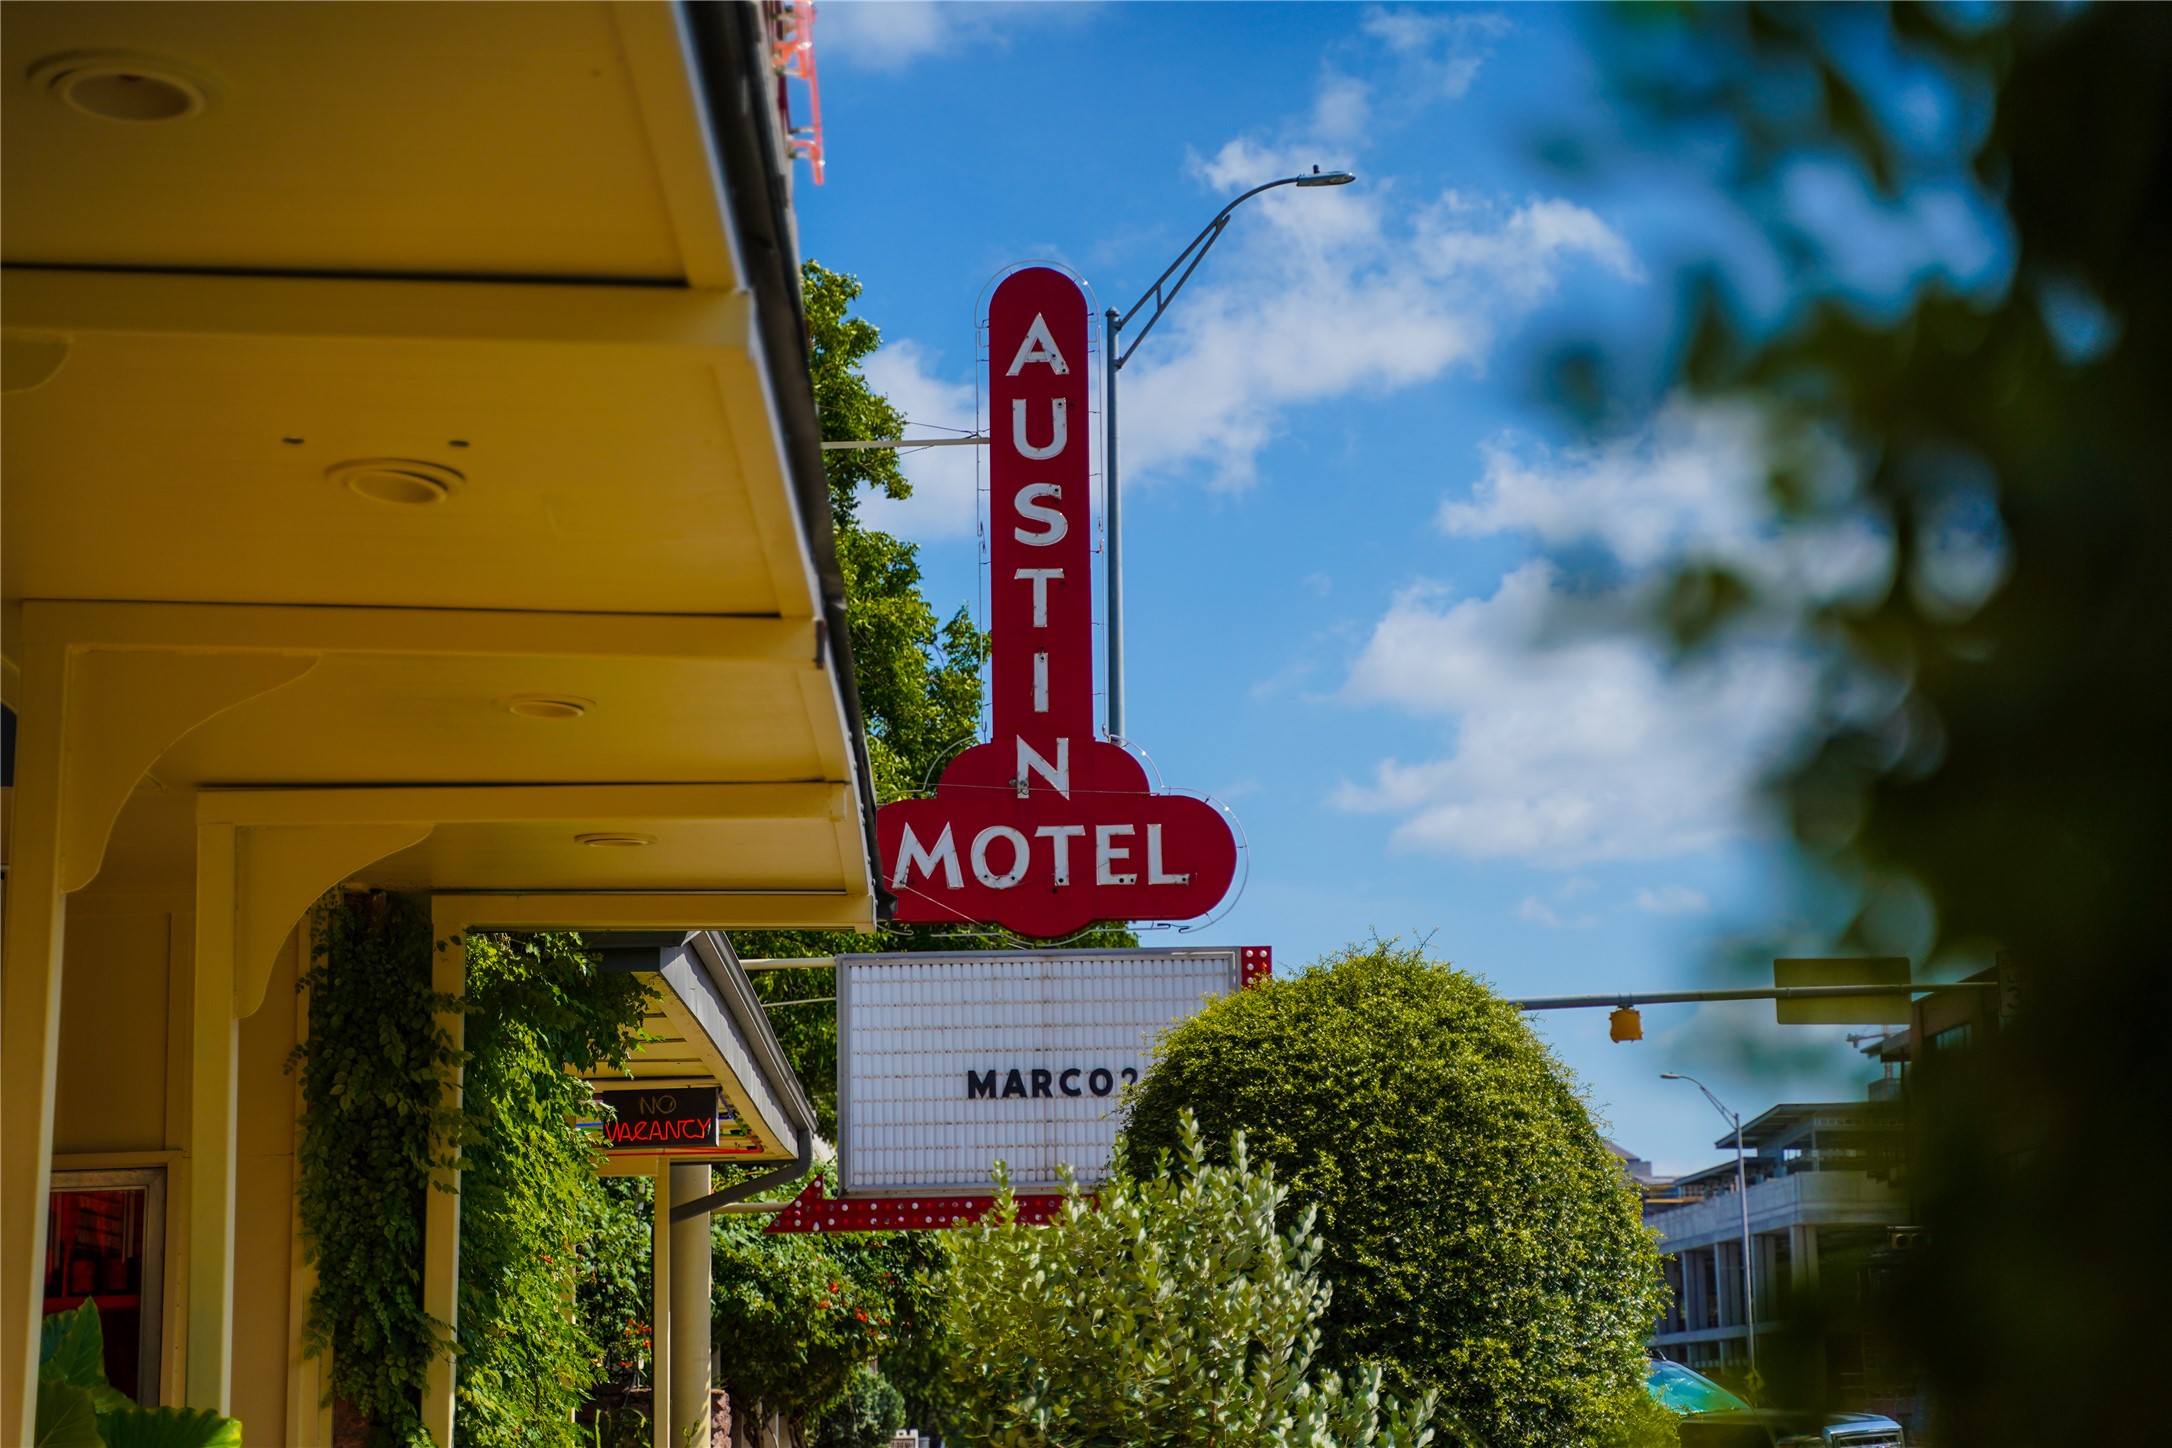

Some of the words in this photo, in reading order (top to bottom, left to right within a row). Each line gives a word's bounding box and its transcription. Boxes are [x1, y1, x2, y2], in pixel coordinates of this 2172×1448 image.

[1005, 312, 1070, 800] AUSTIN
[891, 821, 1190, 889] MOTEL
[967, 1067, 1138, 1098] MARCO?
[640, 1094, 677, 1115] NO
[604, 1117, 711, 1142] VACANCY
